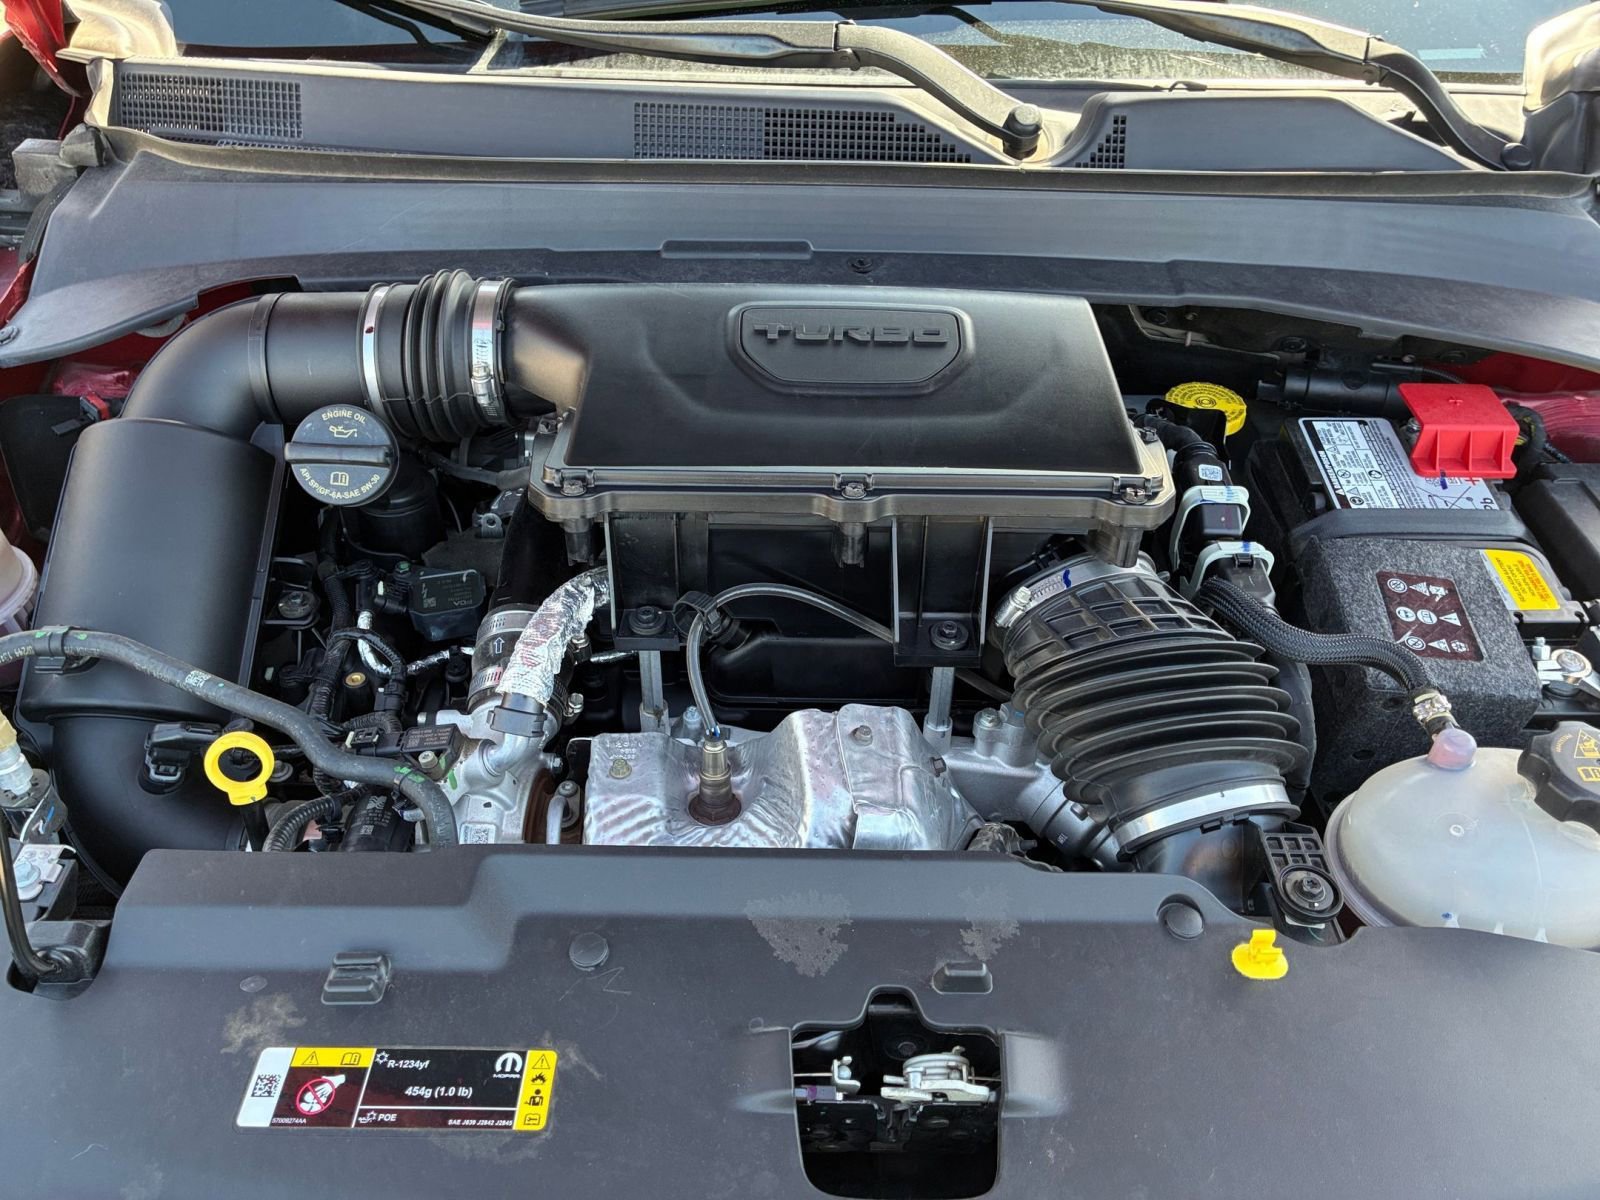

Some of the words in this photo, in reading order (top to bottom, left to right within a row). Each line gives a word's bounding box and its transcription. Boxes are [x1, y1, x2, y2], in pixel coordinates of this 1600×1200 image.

[753, 322, 948, 343] TURBO
[321, 409, 353, 421] ENGINE
[353, 412, 366, 424] OIL
[299, 467, 311, 482] API
[360, 473, 381, 494] 5W-30
[387, 1060, 430, 1070] R-1234yf
[404, 1086, 433, 1098] 454g
[434, 1086, 456, 1098] (1.0
[457, 1087, 473, 1098] lb)
[378, 1114, 397, 1122] POE
